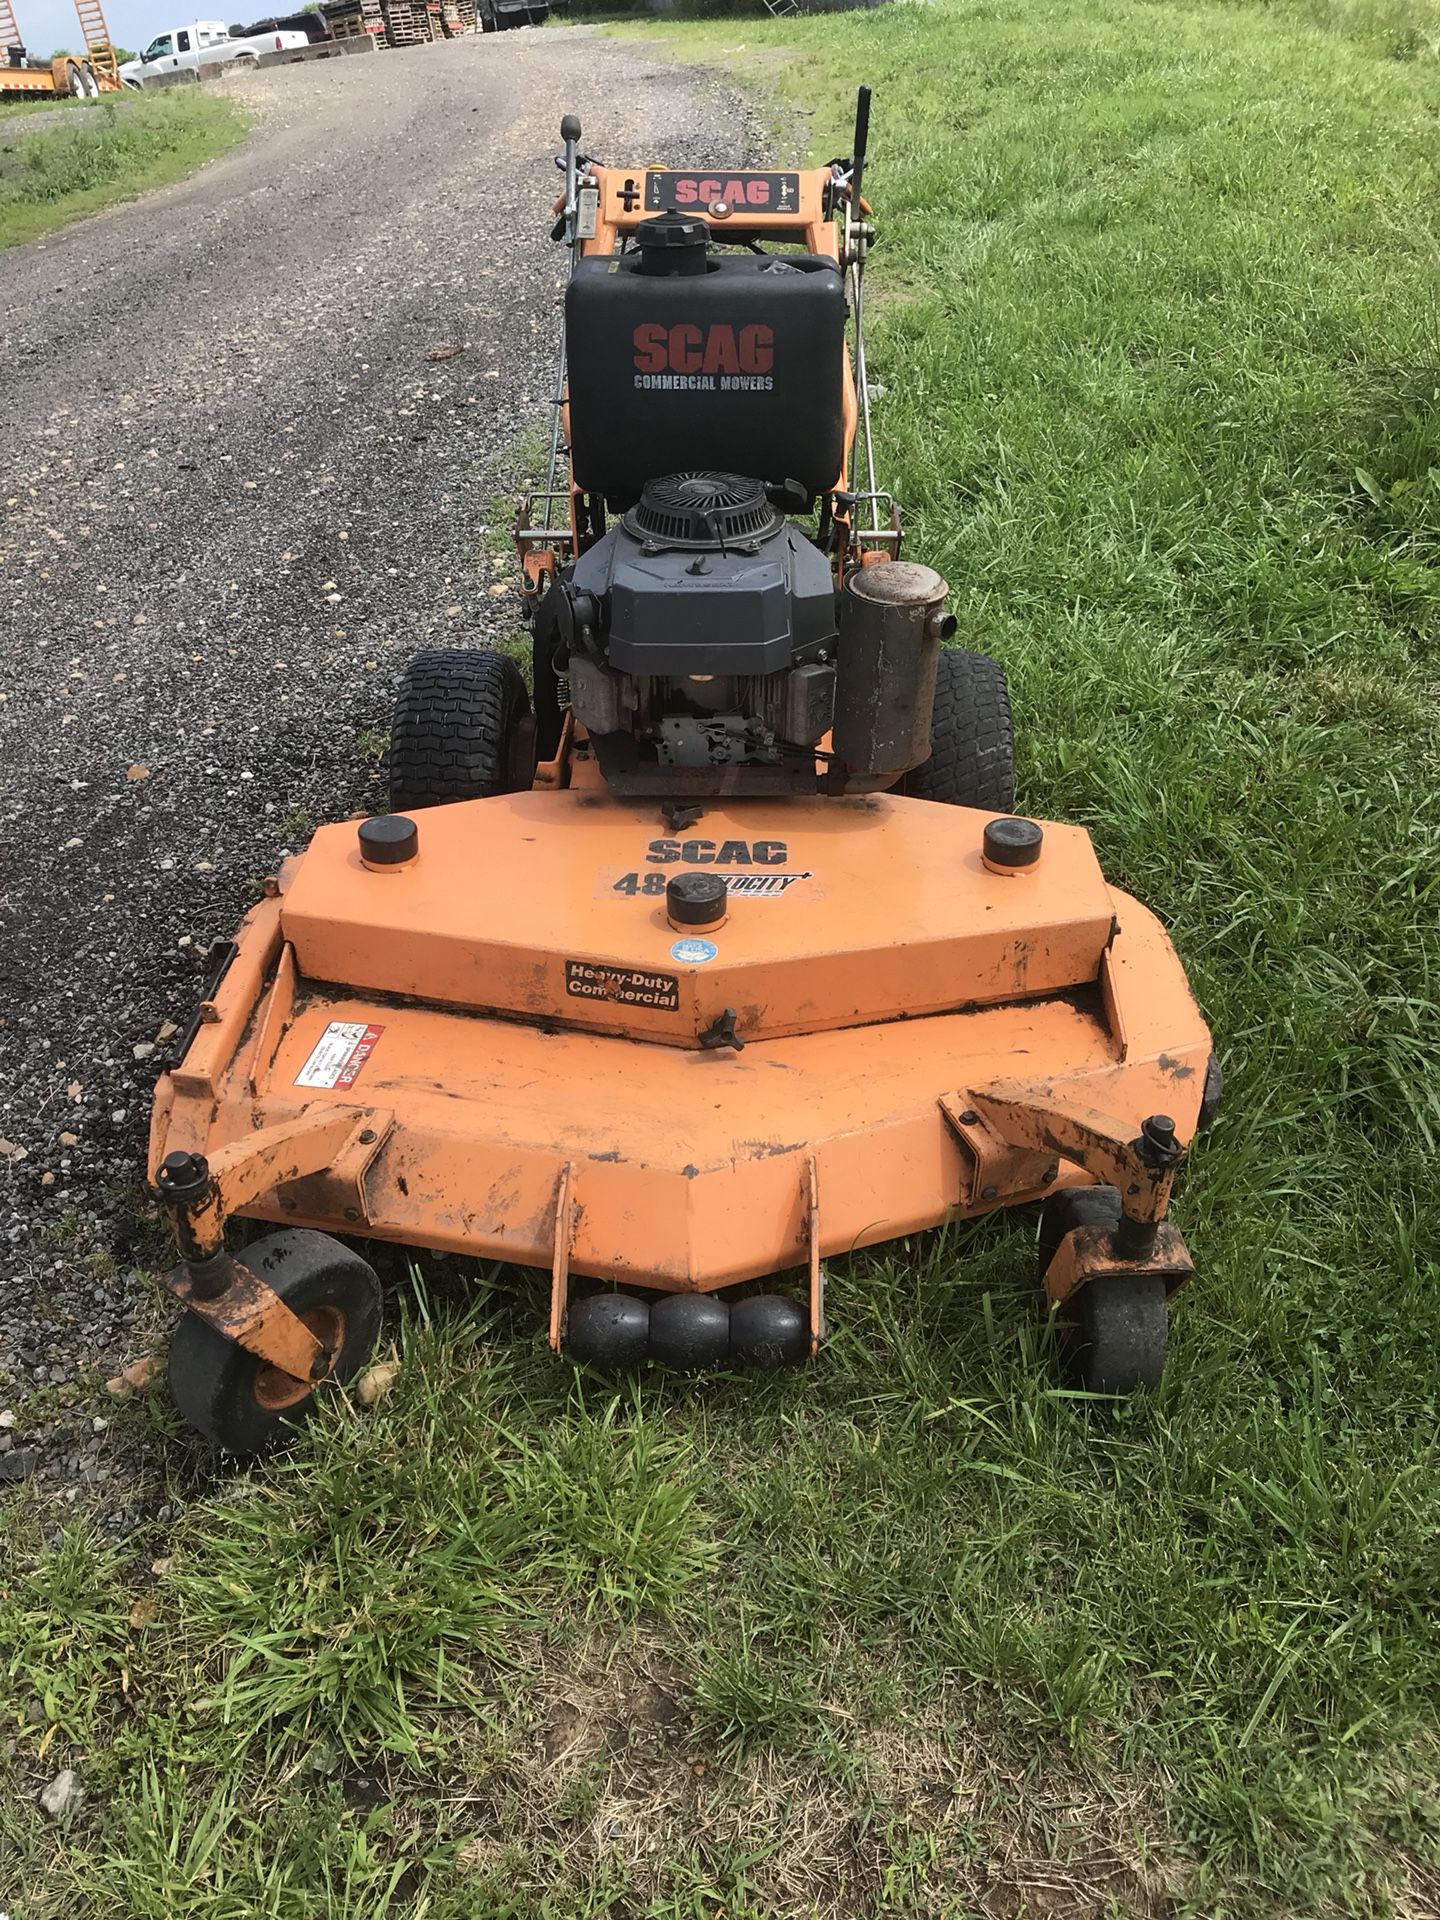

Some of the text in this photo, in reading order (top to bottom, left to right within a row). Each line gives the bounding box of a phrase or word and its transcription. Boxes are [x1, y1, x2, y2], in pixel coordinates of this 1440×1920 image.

[675, 179, 769, 204] SCAG
[634, 323, 774, 373] SCAG
[634, 375, 774, 390] COMMERCIAL MOWERS
[646, 840, 787, 865] SCAG
[612, 873, 666, 895] 48
